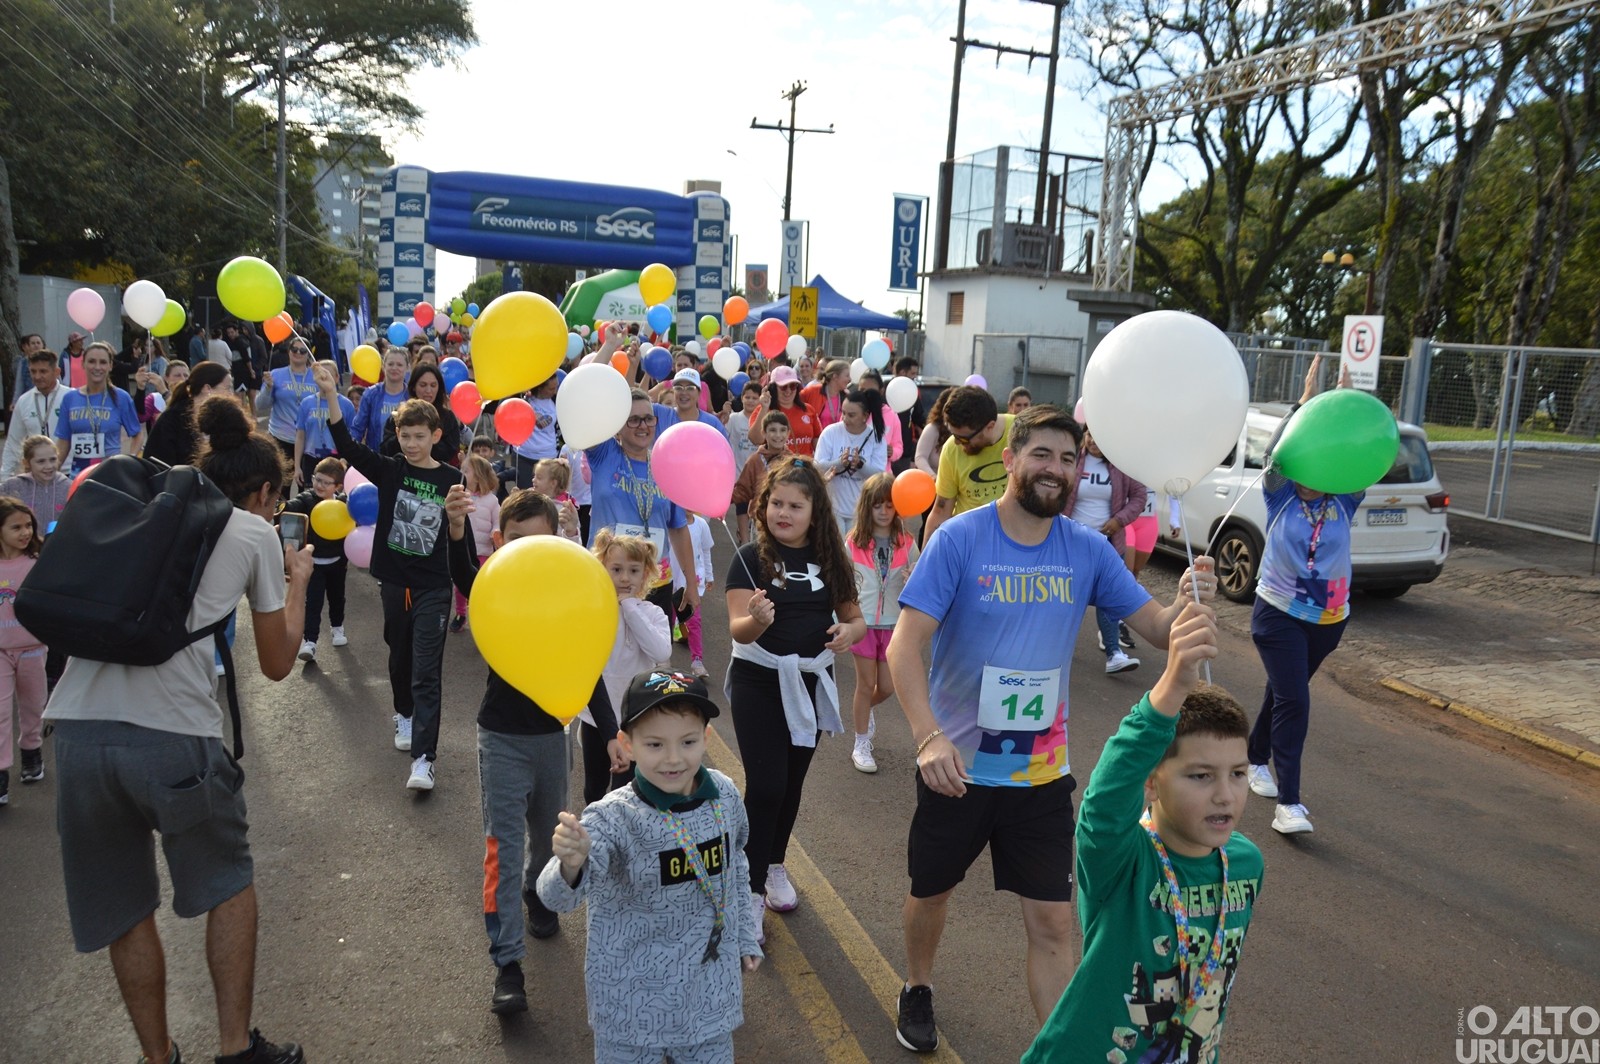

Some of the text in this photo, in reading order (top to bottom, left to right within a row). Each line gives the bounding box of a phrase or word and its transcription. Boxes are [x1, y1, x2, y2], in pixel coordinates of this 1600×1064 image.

[400, 202, 422, 212] Sesc
[482, 213, 578, 233] Fecomércio RS
[595, 213, 655, 240] Sesc
[398, 252, 421, 262] Sesc
[898, 226, 915, 287] URI
[398, 301, 415, 311] Ses
[75, 444, 99, 455] 551
[403, 476, 438, 494] STREET
[989, 565, 1014, 573] DESAFIO
[999, 674, 1026, 687] Sesc
[1002, 694, 1044, 721] 14
